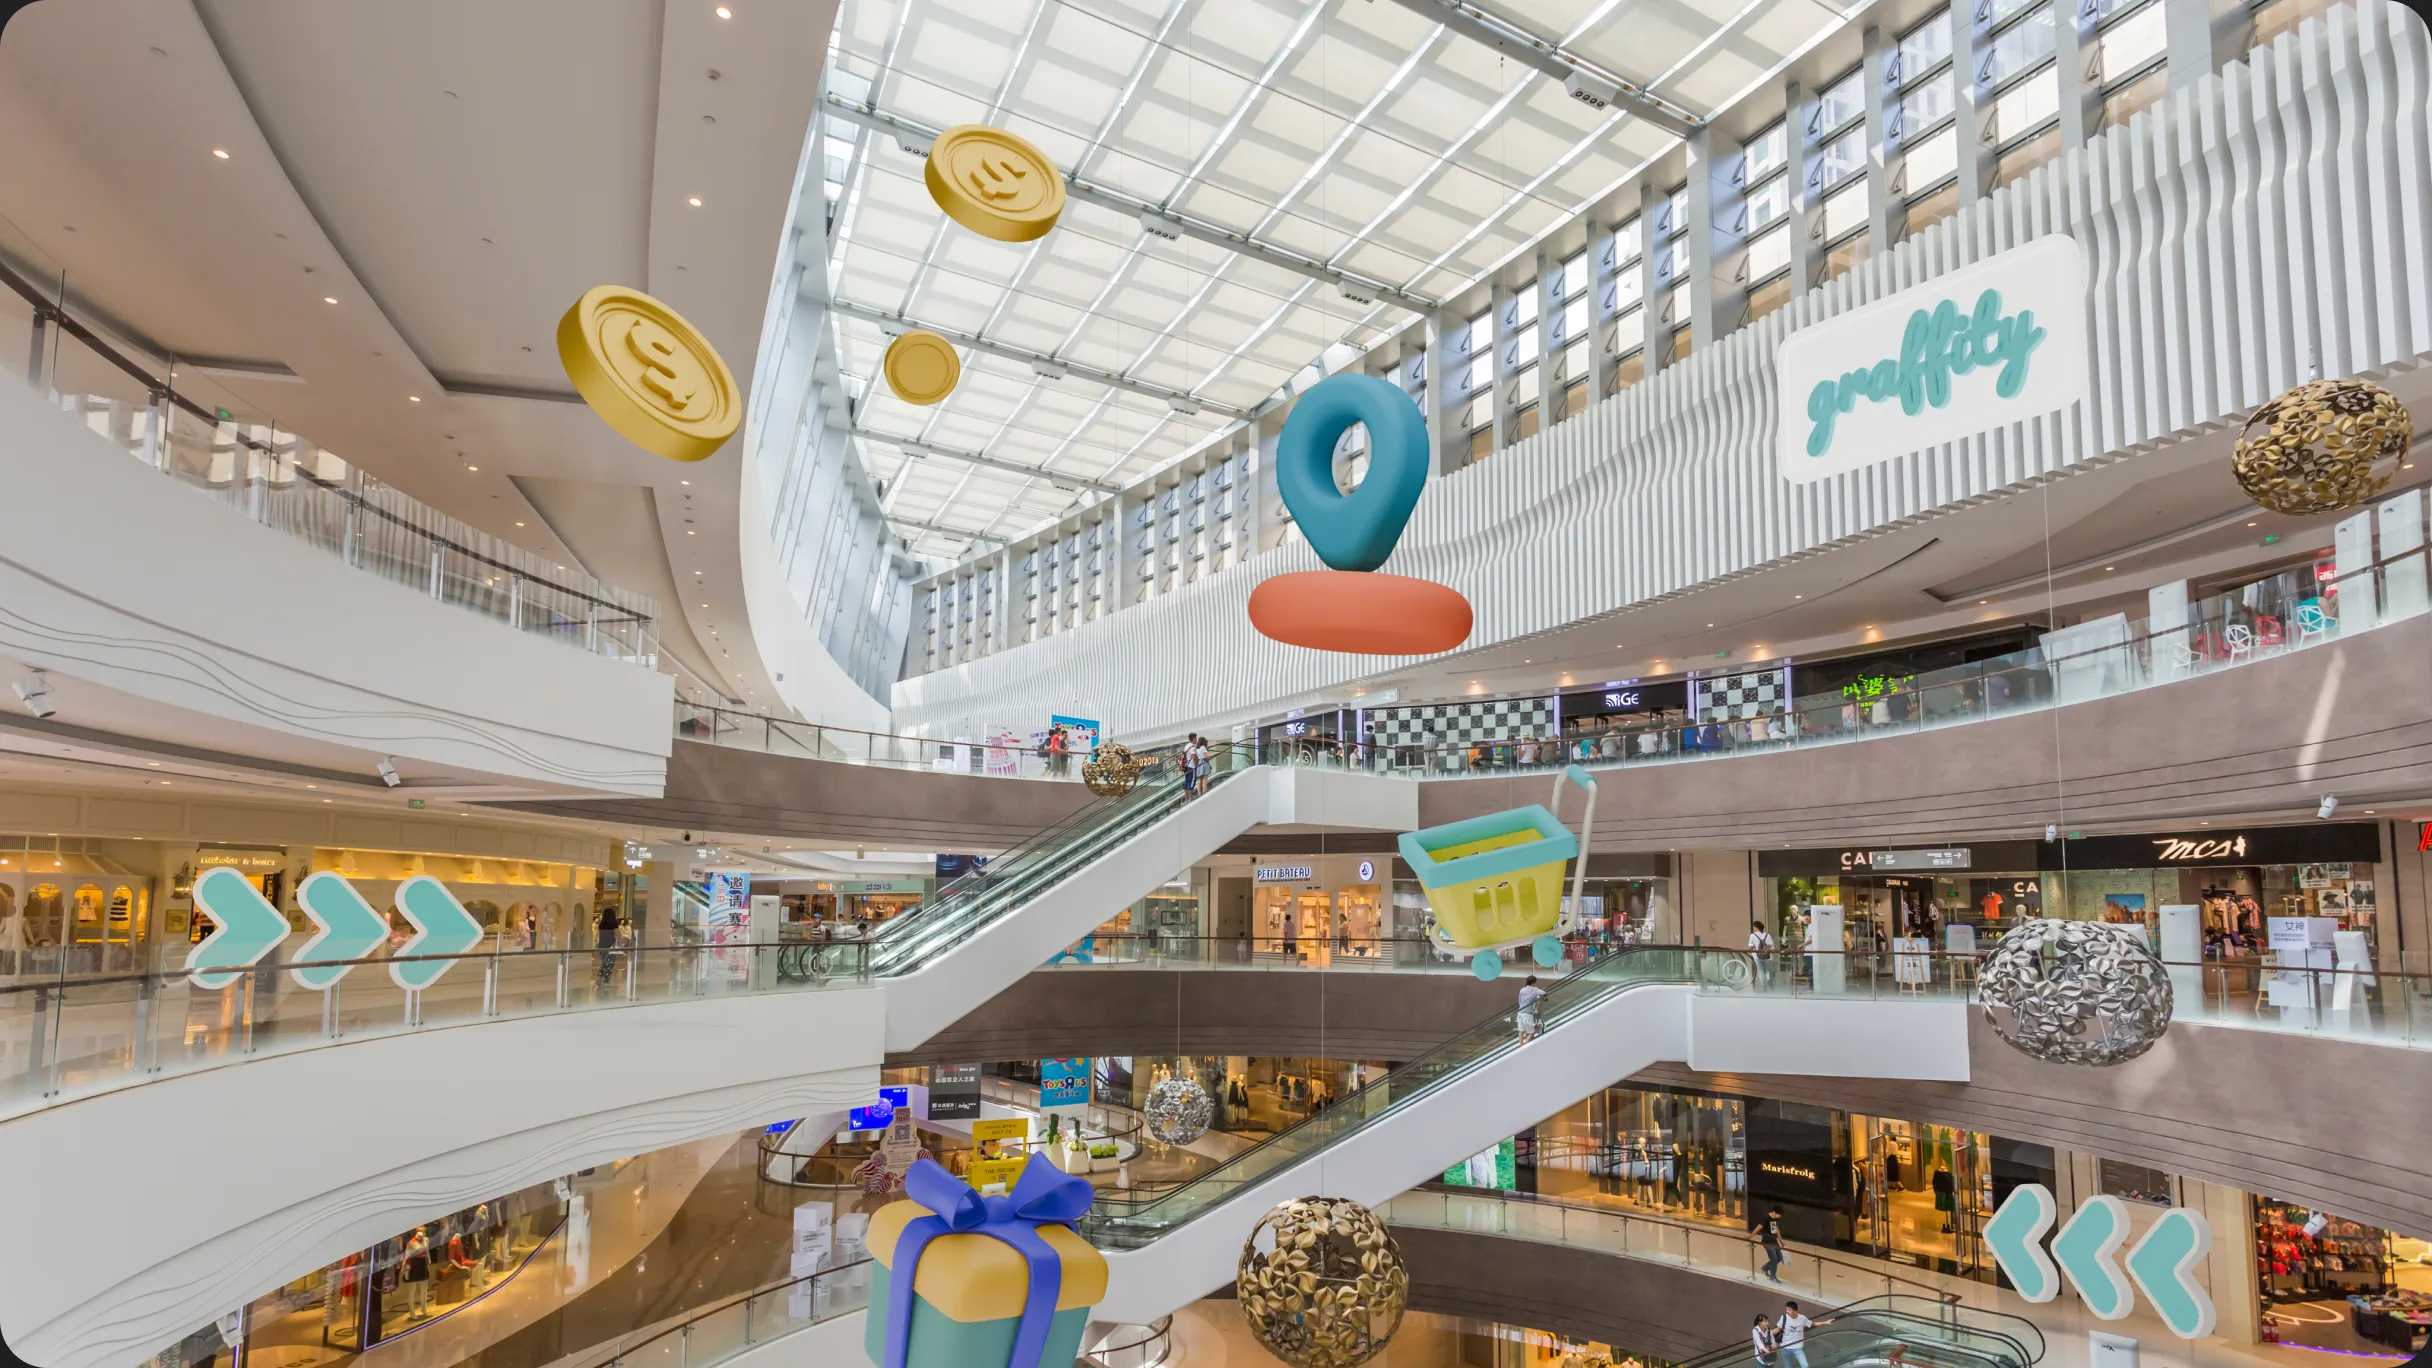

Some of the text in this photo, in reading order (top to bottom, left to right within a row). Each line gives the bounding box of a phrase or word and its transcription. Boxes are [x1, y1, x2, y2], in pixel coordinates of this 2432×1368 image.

[1257, 867, 1311, 879] PETIT BATEAU
[729, 876, 744, 925] 邀请赛
[1762, 1162, 1815, 1180] Marisfrolg
